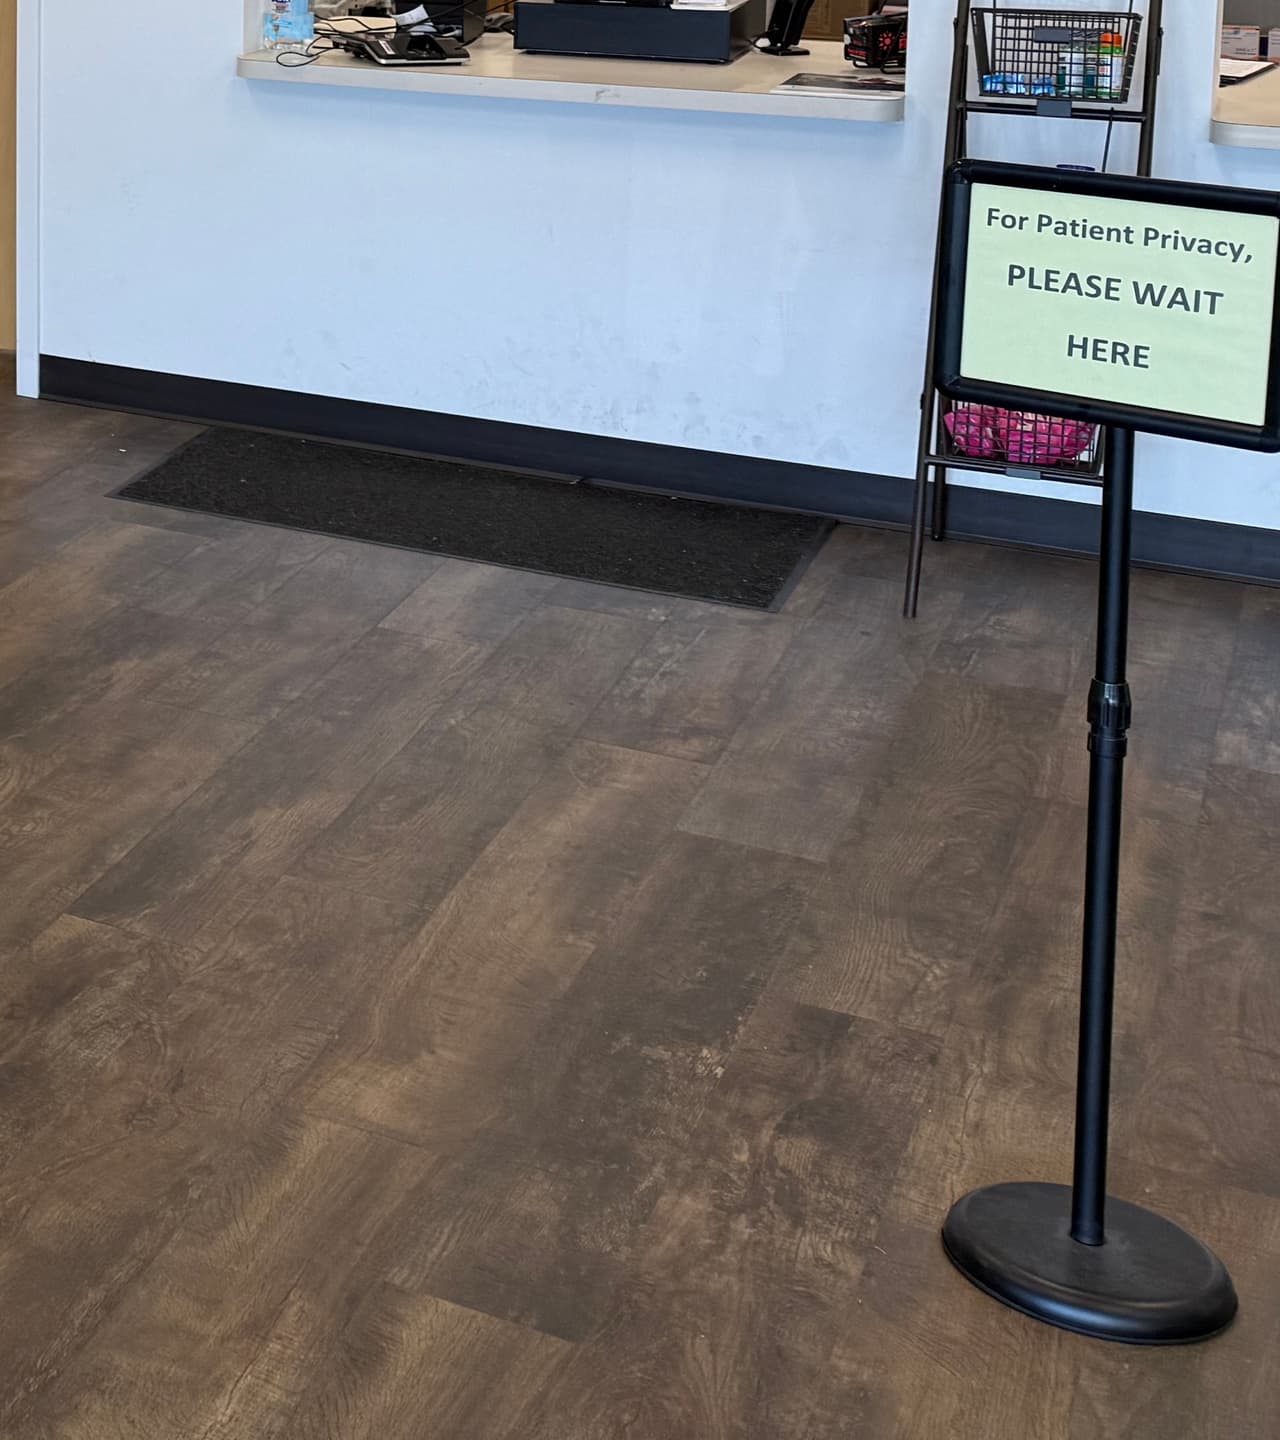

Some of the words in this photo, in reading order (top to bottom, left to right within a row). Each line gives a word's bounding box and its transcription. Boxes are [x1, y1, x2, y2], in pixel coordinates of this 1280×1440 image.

[987, 207, 1029, 230] For
[1037, 214, 1135, 245] Patient
[1143, 227, 1254, 264] Privacy,
[1007, 264, 1122, 301] PLEASE
[1132, 281, 1224, 315] WAIT
[1067, 334, 1151, 369] HERE
